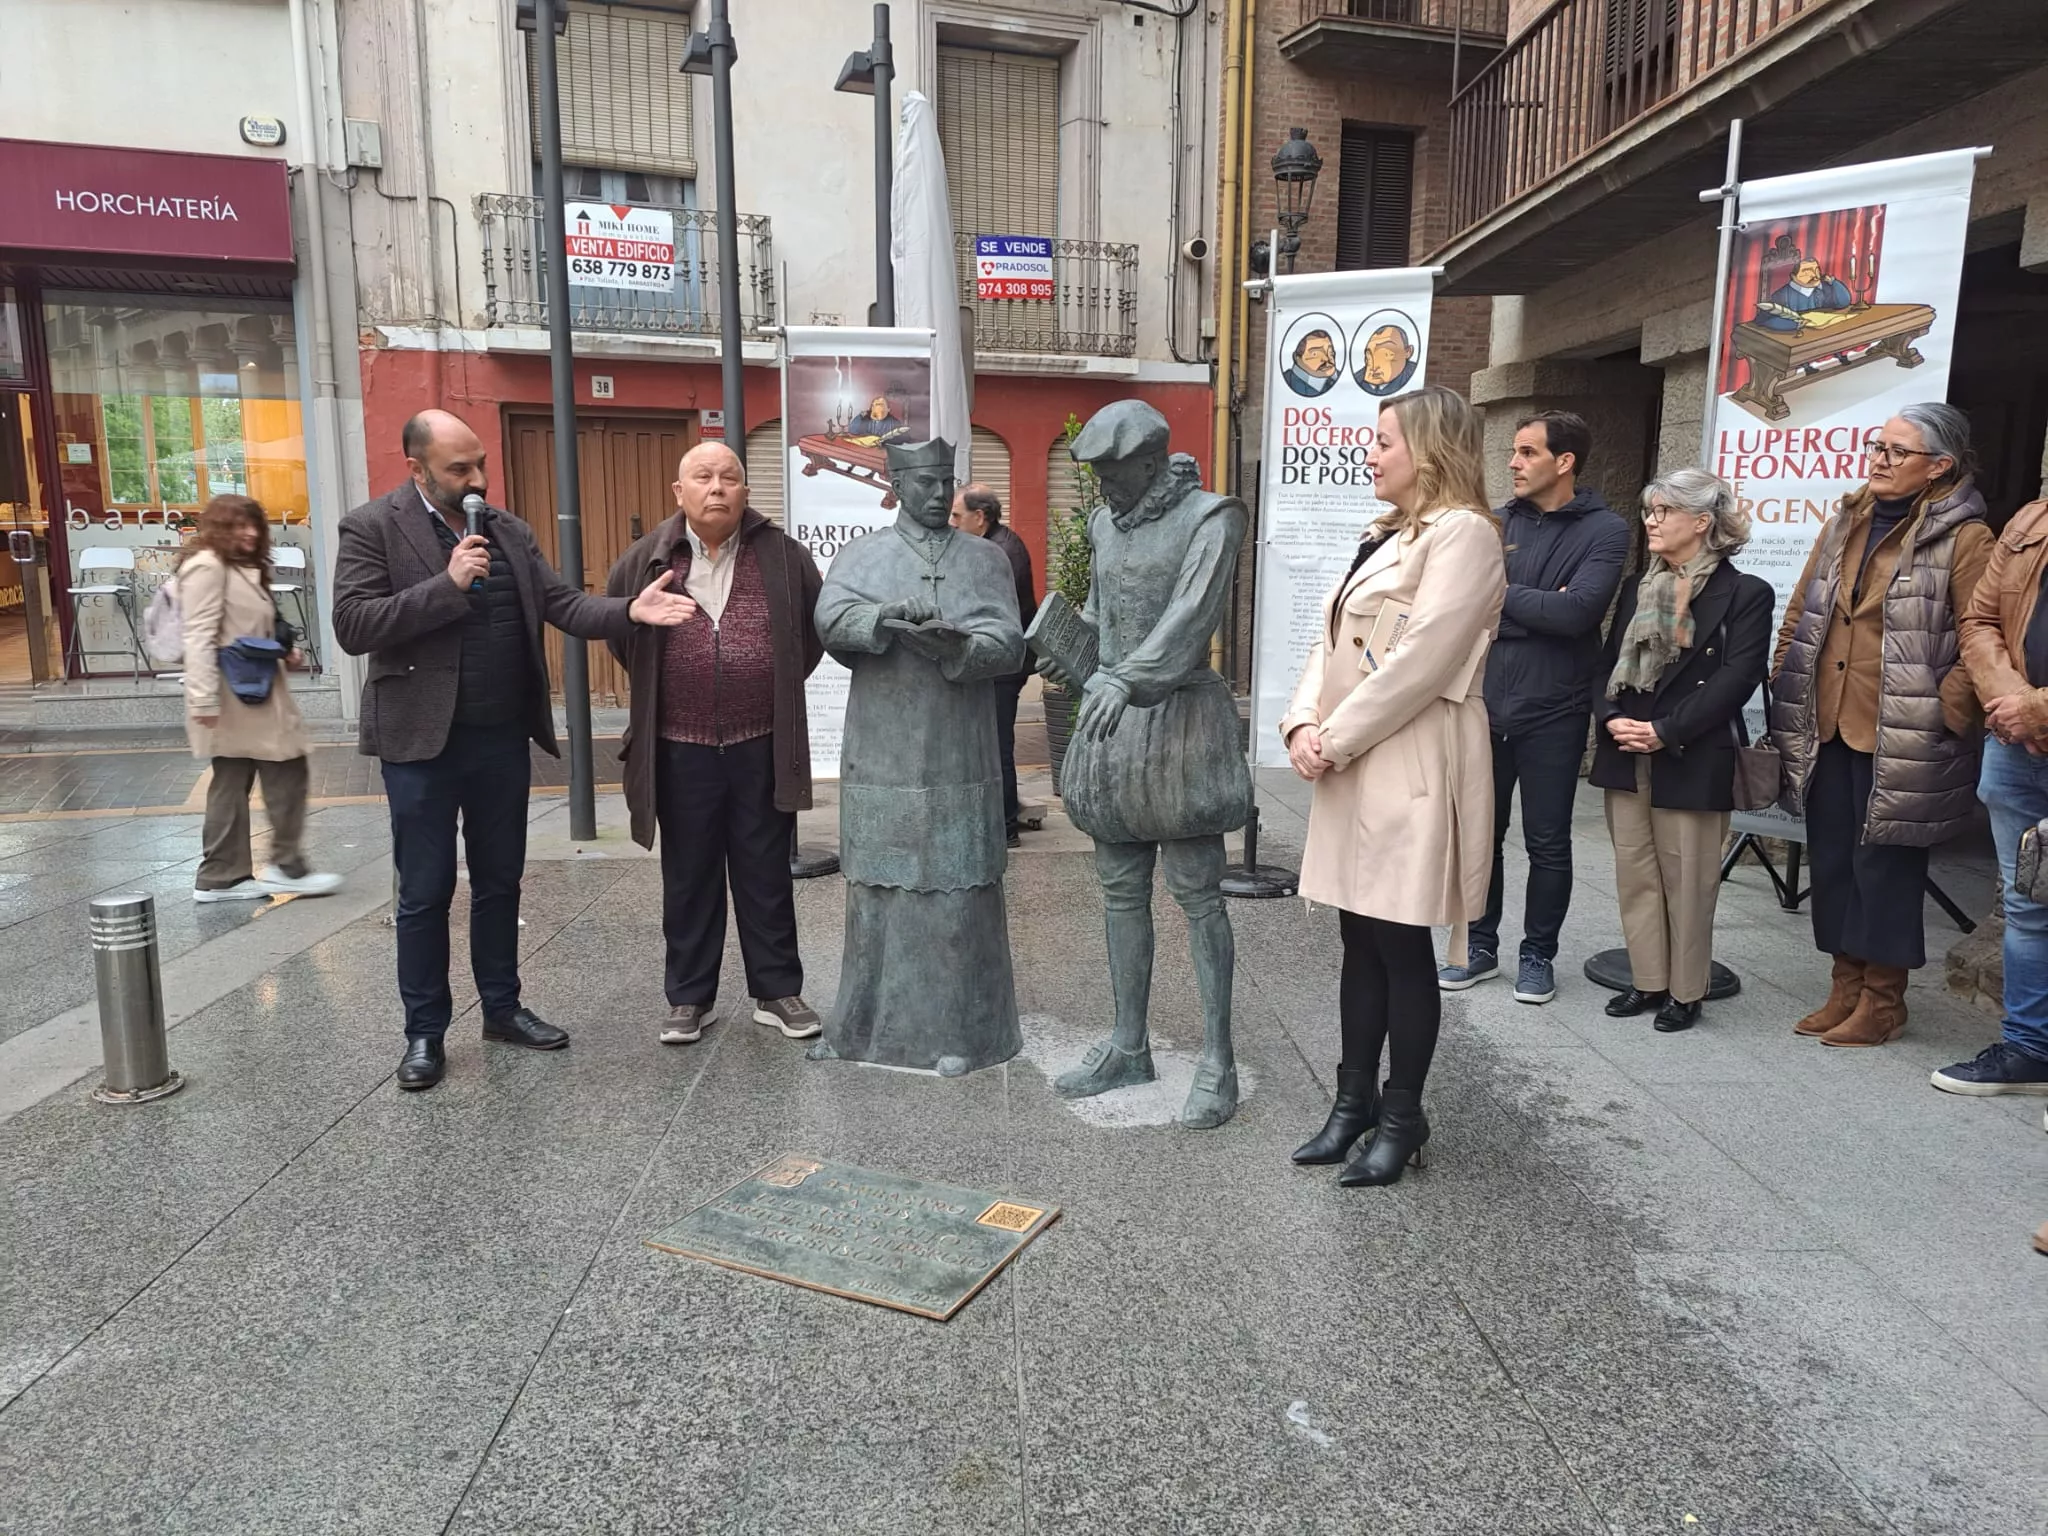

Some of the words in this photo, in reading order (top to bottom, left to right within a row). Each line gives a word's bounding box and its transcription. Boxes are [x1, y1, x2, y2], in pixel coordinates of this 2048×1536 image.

[55, 189, 239, 222] HORCHATERÍA
[599, 220, 624, 231] MIKI
[627, 223, 660, 235] HOME
[571, 238, 614, 256] VENTA
[616, 241, 670, 262] EDIFICIO
[980, 241, 998, 253] SE
[1004, 242, 1047, 254] VENDE
[572, 258, 603, 274] 638
[608, 261, 637, 278] 779
[642, 264, 670, 280] 873
[996, 262, 1048, 272] PRADOSOL
[978, 282, 1002, 295] 974
[1006, 283, 1028, 296] 308
[1030, 284, 1052, 296] 995
[1284, 407, 1332, 426] DOS
[1283, 426, 1374, 446] LUCERO
[1282, 446, 1330, 466] DOS
[1338, 446, 1367, 466] SO
[1282, 466, 1310, 485] DE
[1318, 466, 1372, 486] POES
[1734, 482, 1744, 498] E
[798, 524, 873, 541] BARTO
[1770, 548, 1800, 556] estudió
[1752, 558, 1792, 568] Zaragoza.
